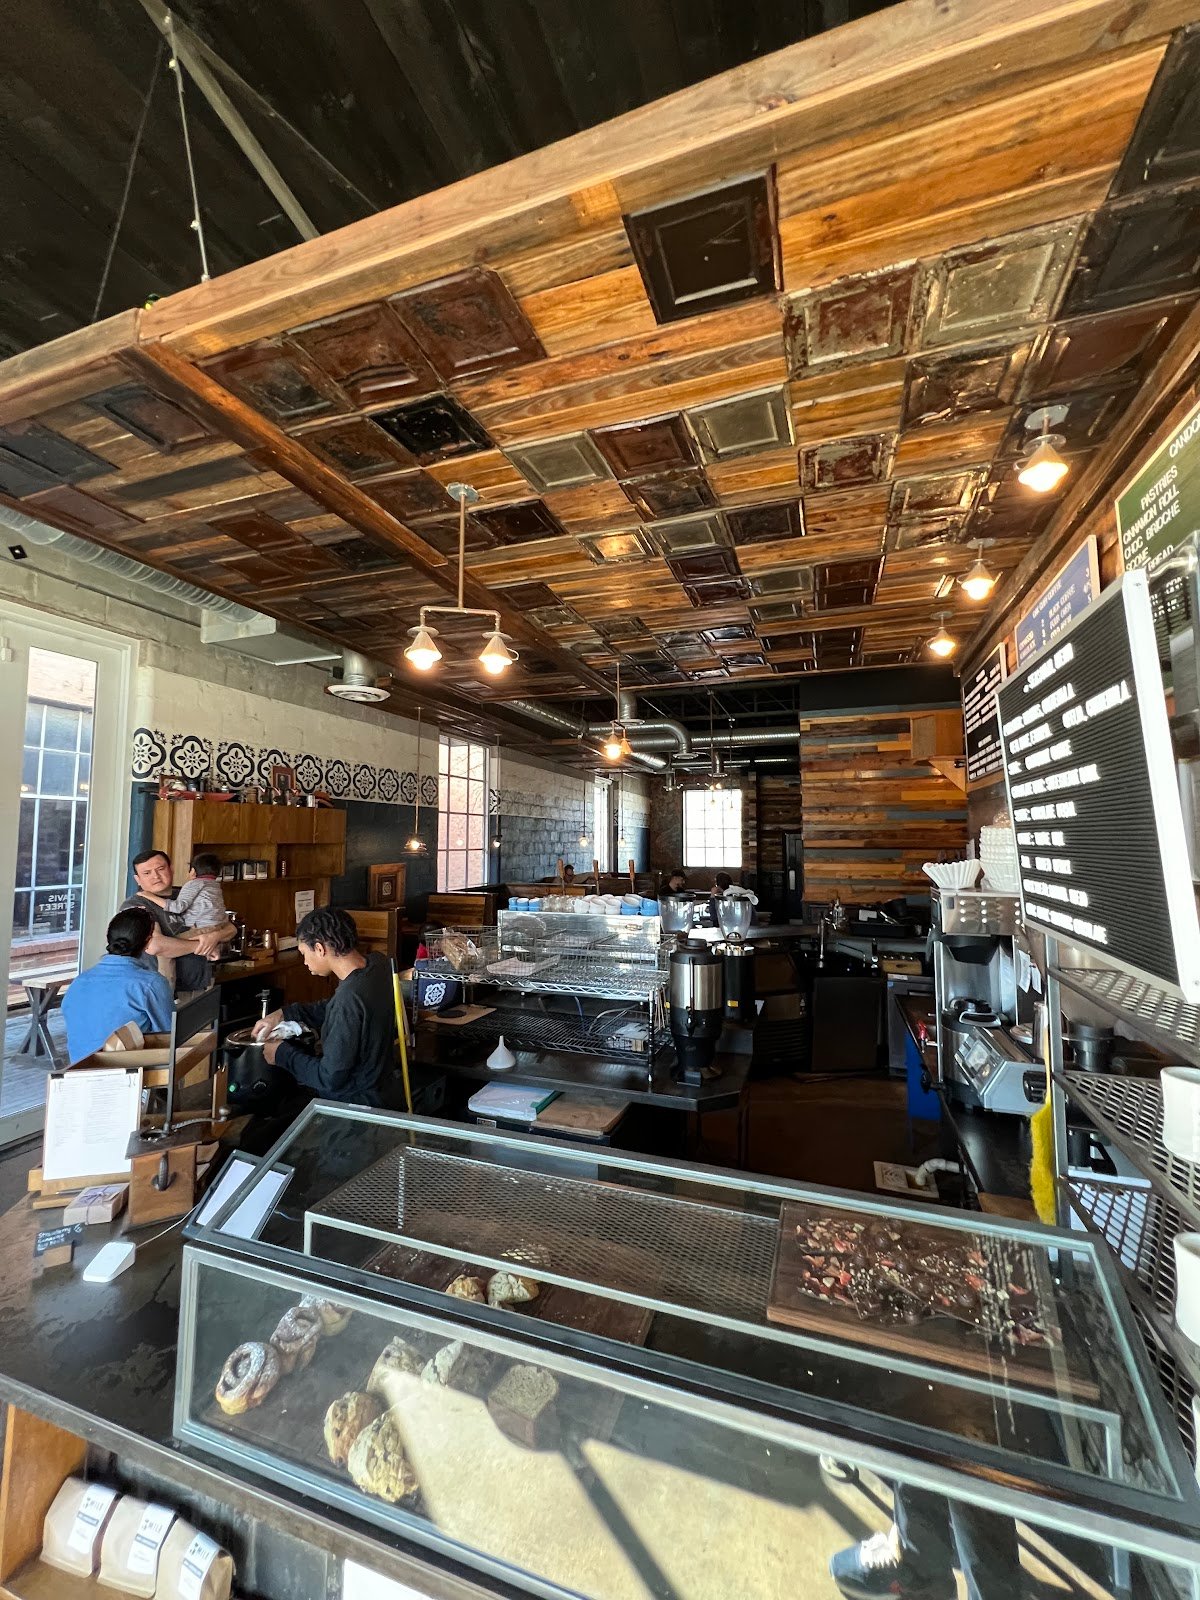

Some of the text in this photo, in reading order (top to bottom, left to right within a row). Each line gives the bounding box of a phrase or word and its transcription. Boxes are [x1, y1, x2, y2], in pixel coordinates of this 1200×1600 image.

[1123, 484, 1180, 545] CINNAMON ROLL
[1141, 465, 1179, 511] PASTRIES
[1124, 500, 1181, 560] CHOC BRIOCHE
